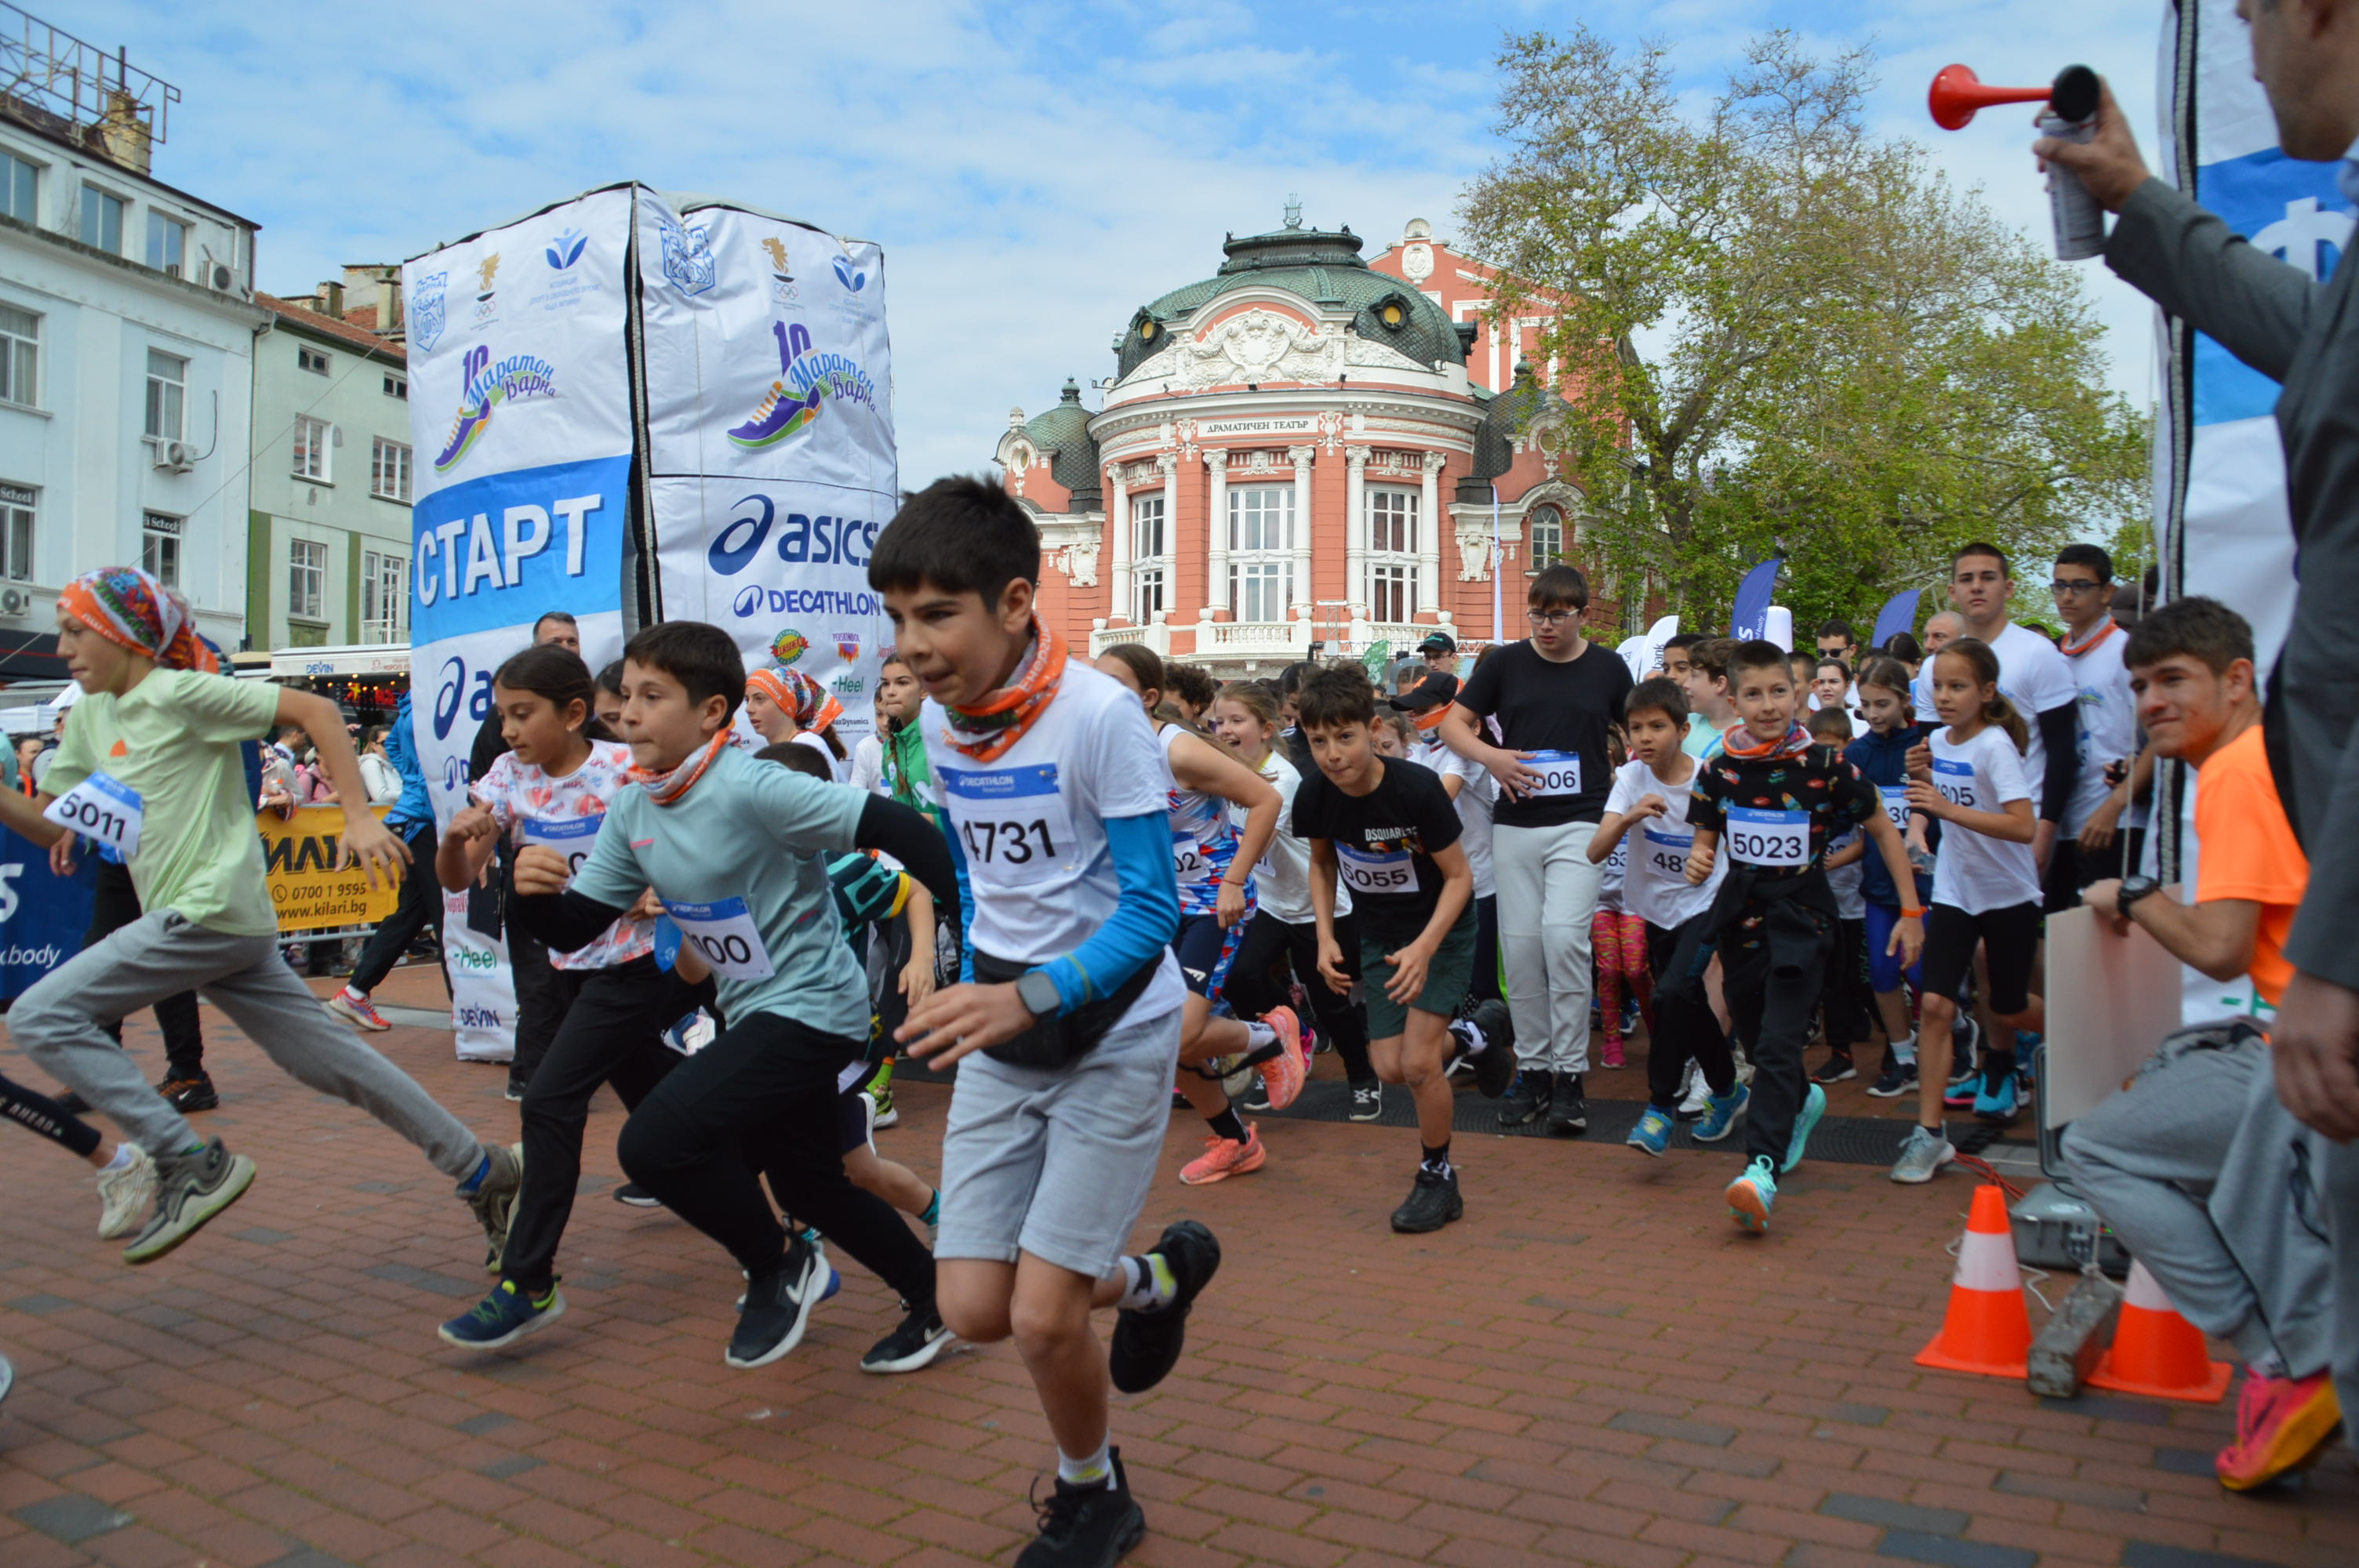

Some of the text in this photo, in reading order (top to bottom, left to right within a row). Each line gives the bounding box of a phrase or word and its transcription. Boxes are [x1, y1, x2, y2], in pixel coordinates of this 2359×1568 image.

[773, 320, 812, 377] 10
[463, 345, 489, 401] 10
[468, 355, 554, 412] Маратон
[790, 354, 874, 397] Маратон
[502, 375, 556, 401] Варна
[830, 372, 876, 412] Варна
[1207, 420, 1309, 433] ДРАМАТИЧЕН ТЕАТЪР
[0, 487, 31, 503] School
[151, 517, 178, 532] School
[417, 494, 603, 607] СТАРТ
[768, 590, 881, 615] DECATHLON
[307, 663, 333, 674] DEVIN
[60, 793, 125, 842] 5011
[963, 818, 1056, 864] 4731
[1733, 833, 1802, 858] 5023
[1343, 860, 1408, 887] 5055
[293, 883, 367, 900] 0700 1 9595
[277, 900, 367, 919] www.kilari.bg
[460, 1007, 502, 1029] DEVIN
